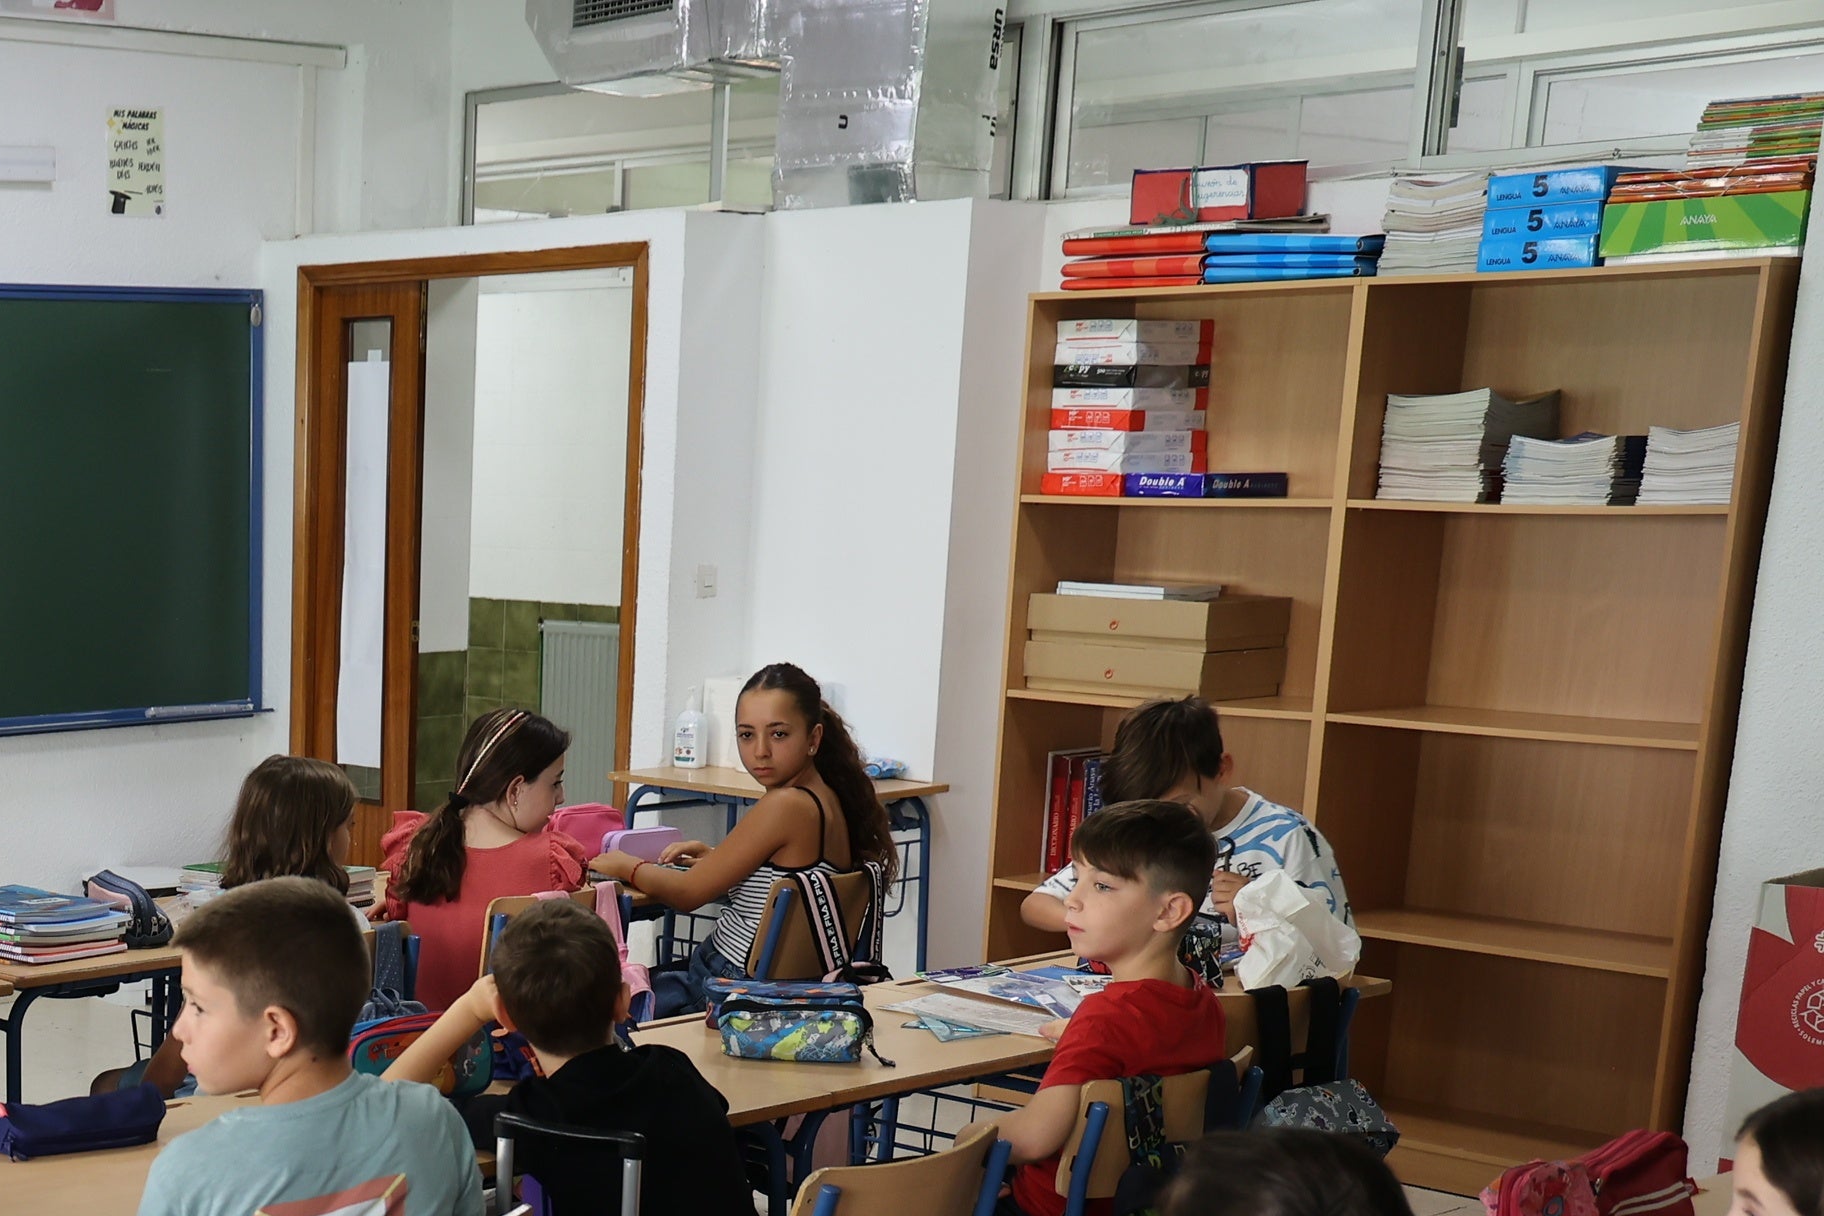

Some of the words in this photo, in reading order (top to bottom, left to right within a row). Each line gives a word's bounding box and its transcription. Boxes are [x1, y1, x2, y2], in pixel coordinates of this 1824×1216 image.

[127, 110, 157, 120] PALABRAS
[1496, 191, 1522, 201] LENGUA
[1532, 174, 1549, 198] 5
[1559, 183, 1593, 195] ANAYA
[1491, 226, 1517, 235] LENGUA
[1527, 209, 1544, 232] 5
[1553, 219, 1588, 231] ANAYA
[1680, 213, 1719, 226] ANAYA
[1486, 257, 1511, 266] LENGUA
[1522, 241, 1538, 264] 5
[1547, 252, 1582, 263] ANAYA
[1139, 475, 1174, 486] Double
[1176, 477, 1185, 486] A
[1212, 479, 1241, 489] Double
[821, 904, 833, 928] FILA
[830, 935, 841, 959] FILA
[1795, 984, 1812, 1001] PAPEL
[1799, 1030, 1824, 1046] SOLEM
